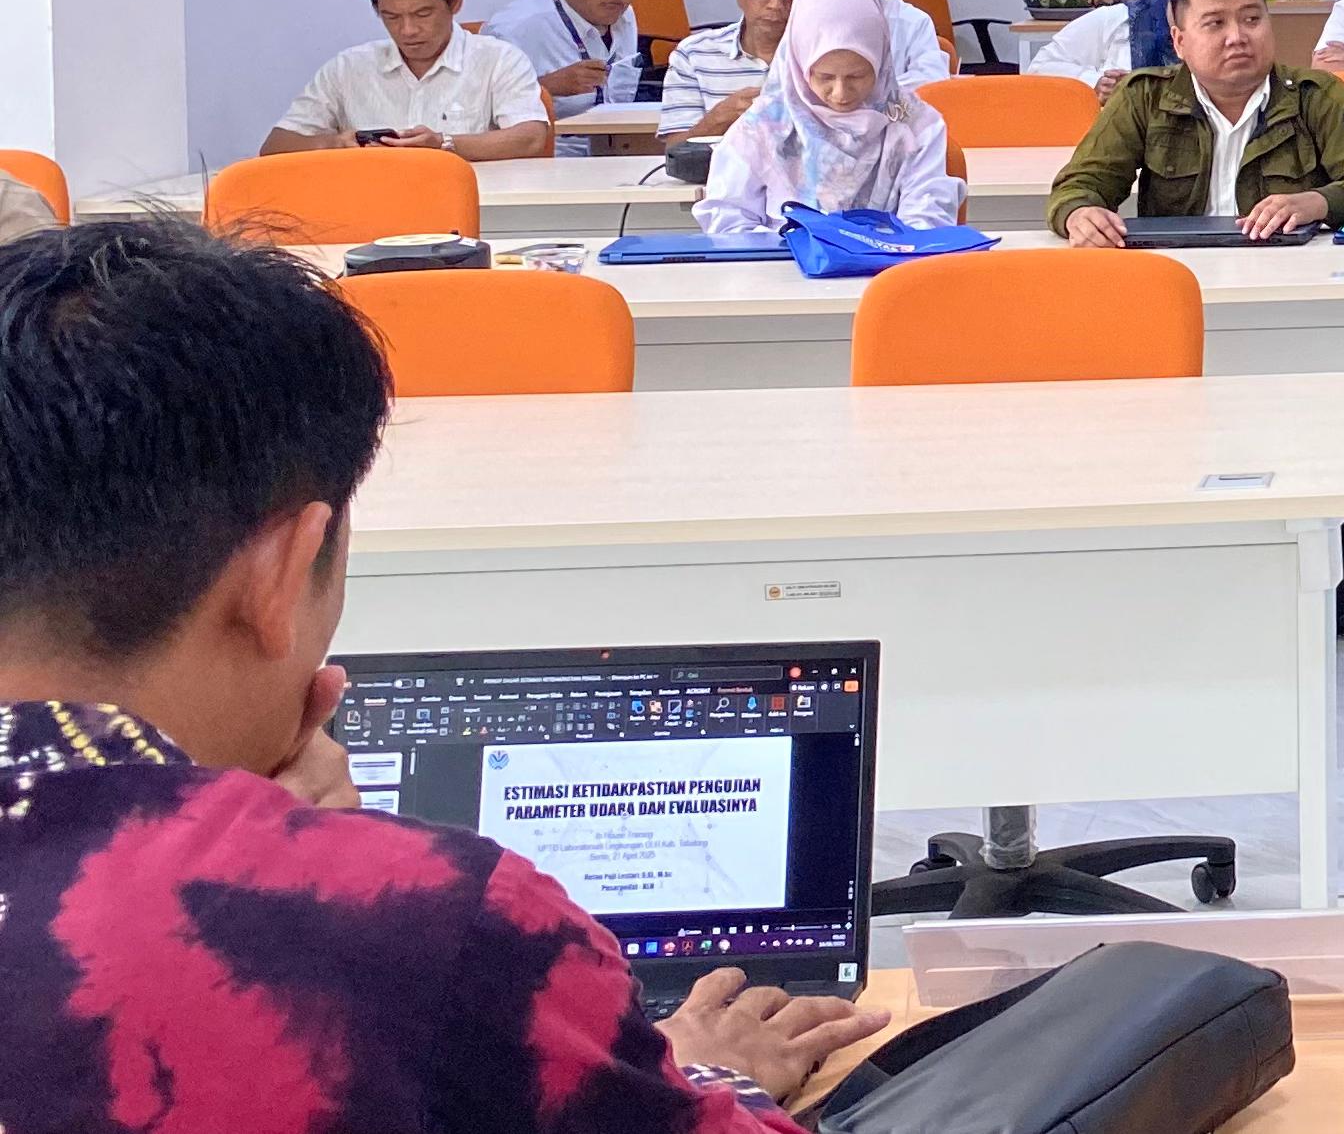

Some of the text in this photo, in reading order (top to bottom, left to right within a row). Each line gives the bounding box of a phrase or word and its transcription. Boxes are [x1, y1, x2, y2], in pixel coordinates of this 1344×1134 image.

[503, 777, 762, 801] ESTIMASI KETIDAKPASTIAN PENGUJIAN
[505, 797, 758, 820] PARAMETER UDARA DAN EVALUASINYA
